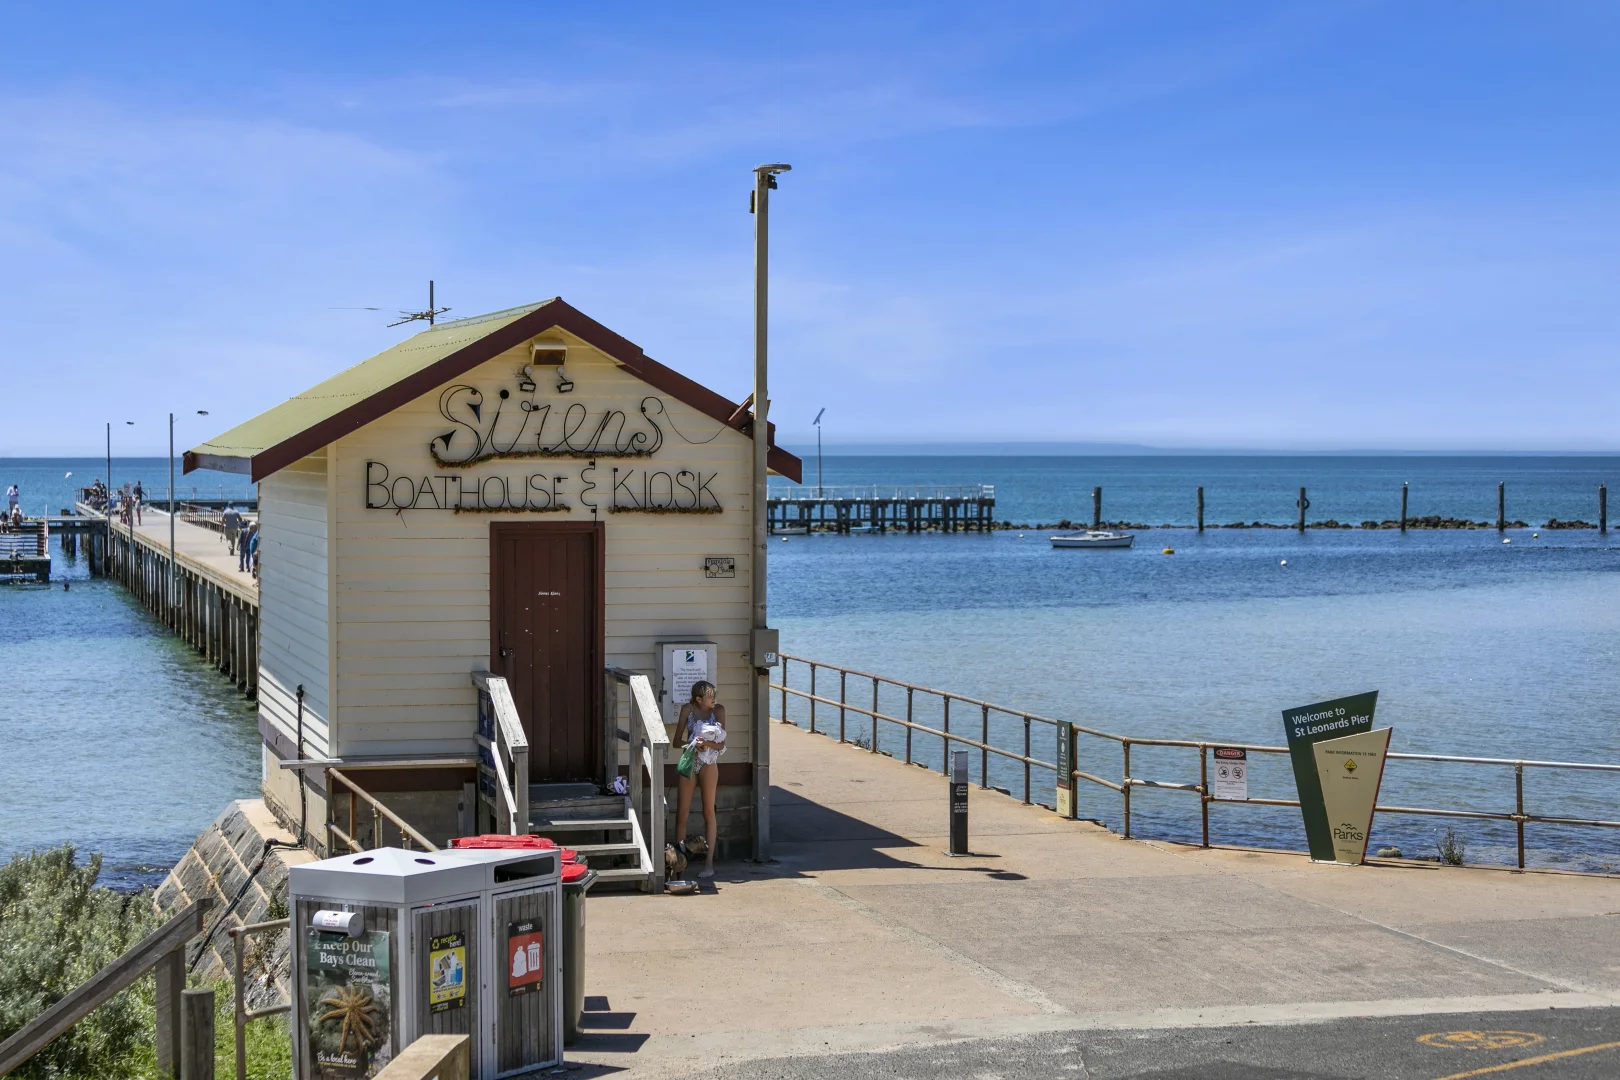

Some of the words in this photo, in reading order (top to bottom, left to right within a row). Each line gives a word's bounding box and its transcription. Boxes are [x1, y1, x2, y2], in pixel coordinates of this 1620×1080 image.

[430, 384, 664, 463] Sirens
[366, 461, 569, 509] BOATHOUSE
[613, 468, 722, 510] KIOSK
[1292, 710, 1334, 725] Welcome
[1335, 707, 1346, 716] to
[1295, 727, 1305, 737] St
[1306, 718, 1349, 735] Leonards
[1350, 715, 1370, 725] Pier
[1333, 828, 1364, 841] Parks
[517, 923, 533, 932] waste
[440, 934, 457, 944] recycle
[449, 939, 461, 948] here!
[351, 940, 372, 953] Our
[319, 951, 344, 967] Bays
[345, 954, 376, 967] Clean
